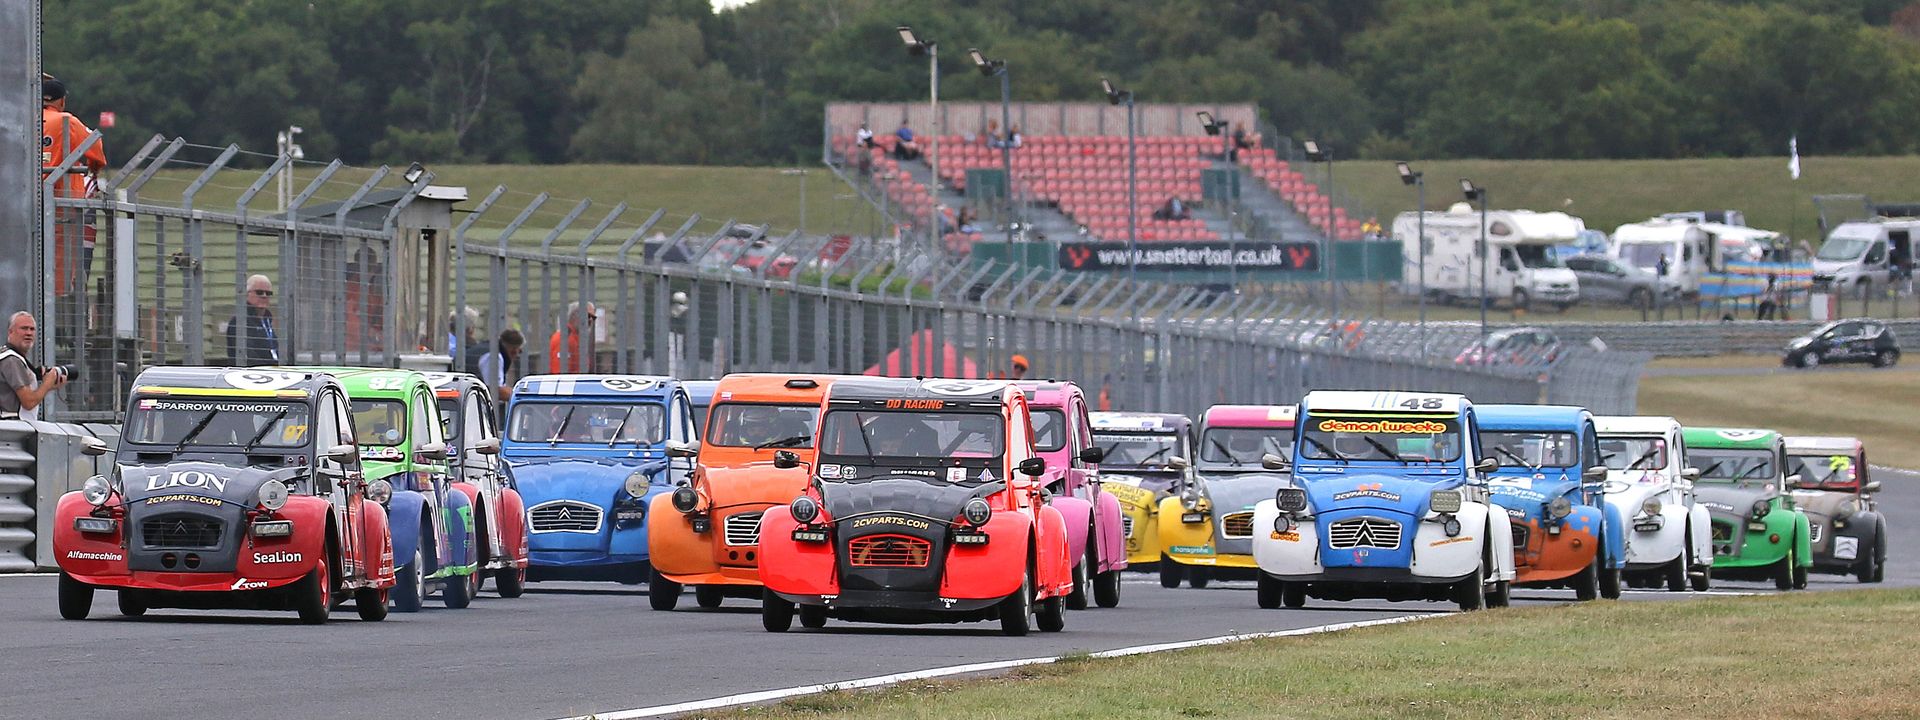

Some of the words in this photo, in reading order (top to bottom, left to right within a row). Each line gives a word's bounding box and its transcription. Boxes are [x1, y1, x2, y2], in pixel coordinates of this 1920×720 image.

[1098, 246, 1282, 266] www.snetterton.co.uk
[368, 377, 404, 390] 92
[156, 402, 211, 411] SPARROW
[214, 403, 289, 412] AUTOMOTIVE
[886, 399, 901, 409] DD
[904, 399, 944, 410] RACING
[1400, 398, 1443, 409] 48
[282, 425, 306, 441] 97
[1319, 420, 1380, 433] demon
[1382, 422, 1447, 434] tweeks
[145, 471, 230, 493] LION
[146, 494, 222, 507] 2CVPARTS.COM
[1334, 490, 1400, 501] 2CVPARTS.COM
[853, 516, 929, 530] 2CVPARTS.COM
[66, 550, 122, 561] Alfamacchine
[253, 550, 302, 564] SeaLion
[242, 581, 268, 589] TOW
